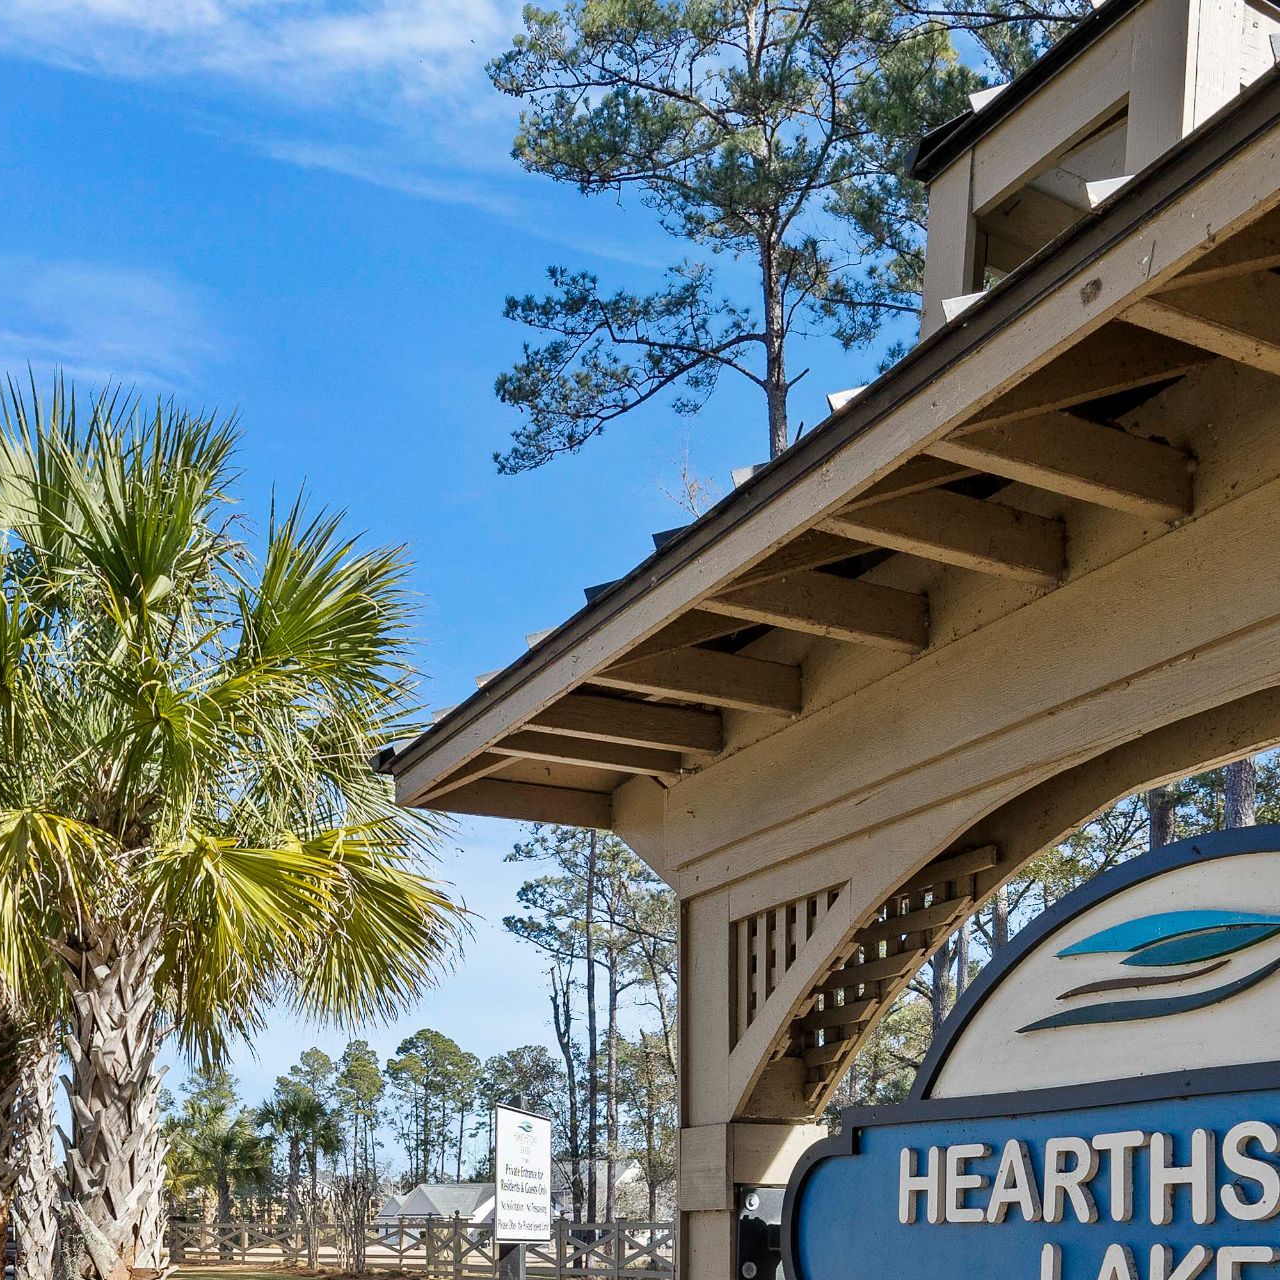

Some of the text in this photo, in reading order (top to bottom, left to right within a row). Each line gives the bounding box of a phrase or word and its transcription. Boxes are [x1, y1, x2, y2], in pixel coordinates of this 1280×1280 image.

[505, 1163, 520, 1177] Private
[521, 1166, 537, 1179] Entrance
[500, 1179, 520, 1193] Residents
[525, 1183, 538, 1195] Guests
